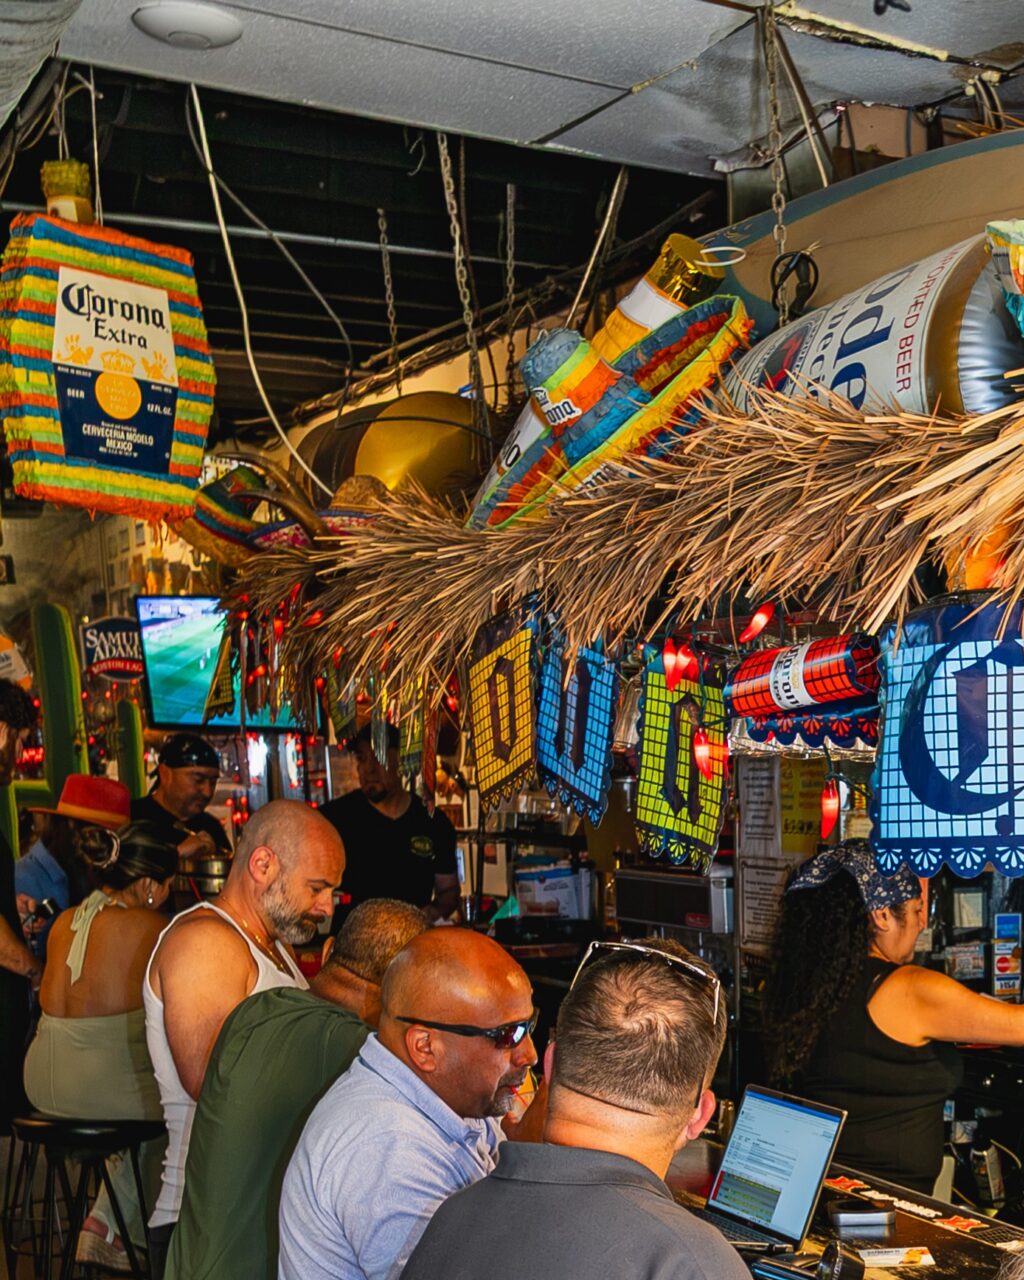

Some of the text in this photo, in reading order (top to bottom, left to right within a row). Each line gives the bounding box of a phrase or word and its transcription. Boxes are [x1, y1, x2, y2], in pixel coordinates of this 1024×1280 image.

[61, 282, 165, 330] Corona
[93, 317, 148, 349] Extra
[896, 334, 914, 393] BEER
[67, 388, 85, 399] BEER
[82, 423, 154, 446] CERVECERIA MODELO
[106, 438, 133, 451] MEXICO
